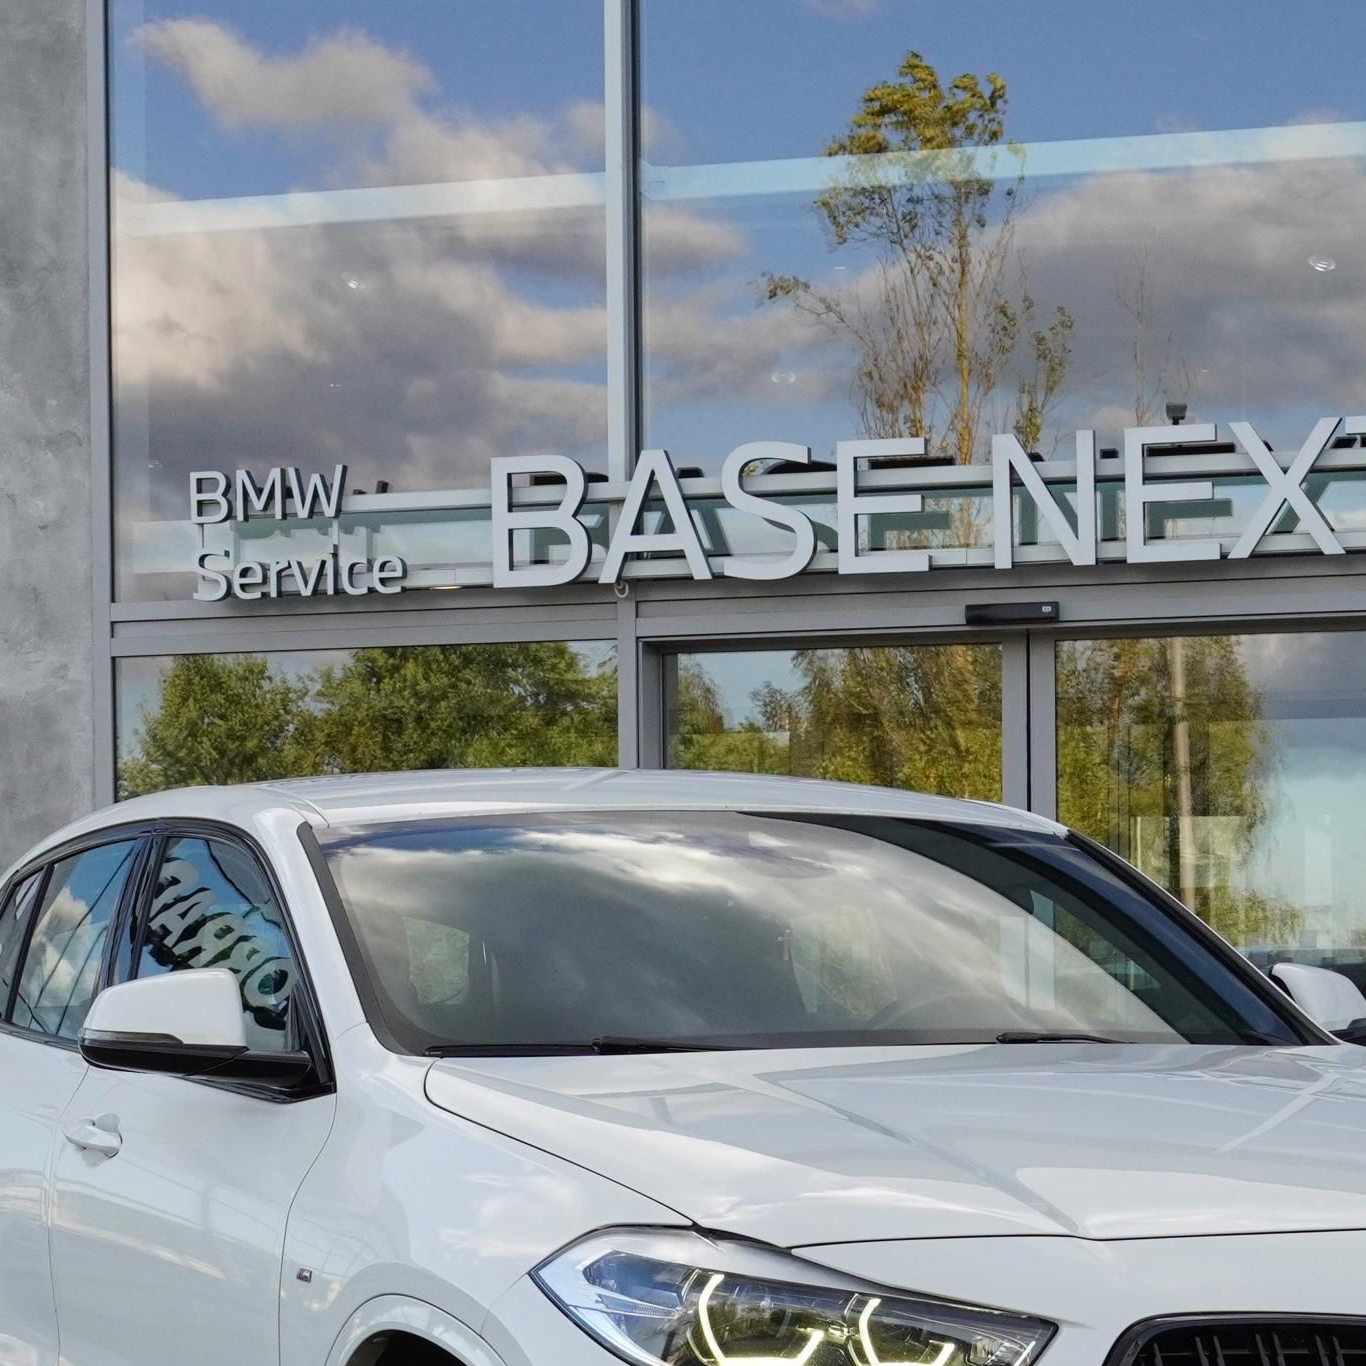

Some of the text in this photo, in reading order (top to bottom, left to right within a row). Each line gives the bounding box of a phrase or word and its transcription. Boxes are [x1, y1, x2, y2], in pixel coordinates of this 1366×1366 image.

[189, 464, 348, 526] BMW
[491, 437, 931, 590] BASE
[194, 543, 407, 602] Service
